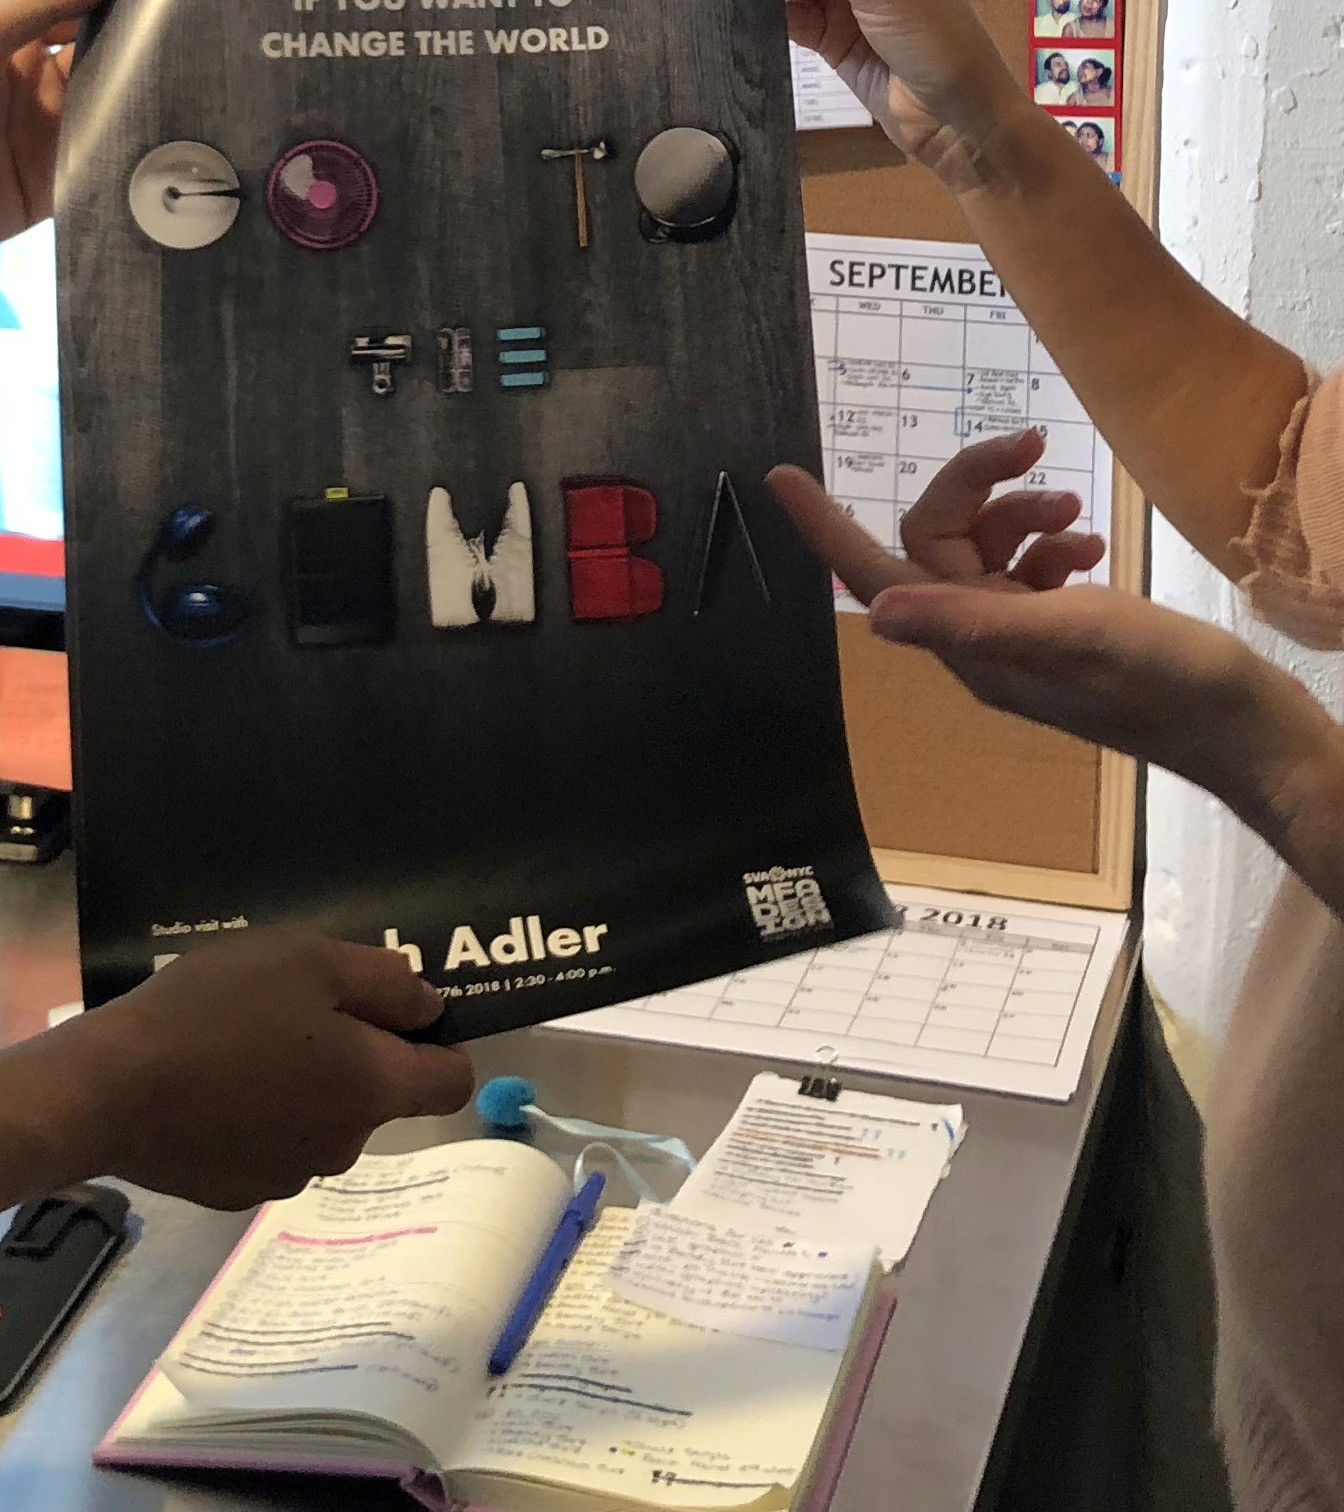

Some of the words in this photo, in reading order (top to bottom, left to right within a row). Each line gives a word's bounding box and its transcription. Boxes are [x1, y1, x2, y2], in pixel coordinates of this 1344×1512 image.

[261, 30, 406, 59] CHANGE
[414, 29, 475, 56] THE
[484, 26, 610, 55] WORLD
[828, 258, 1006, 298] SEPTEMBE
[858, 300, 881, 312] WED
[922, 304, 944, 316] THU
[989, 310, 1007, 320] FRI
[902, 368, 911, 381] 6
[967, 372, 975, 385] 7
[1031, 378, 1040, 391] 8
[838, 409, 855, 423] 12
[902, 414, 918, 428] 13
[967, 419, 983, 433] 14
[837, 455, 853, 469] 19
[899, 461, 917, 474] 20
[1029, 471, 1046, 485] 22
[746, 879, 821, 905] MFA
[152, 920, 192, 937] Studio
[195, 919, 219, 932] visit
[222, 914, 249, 929] with
[919, 907, 1009, 931] 2018
[443, 915, 608, 971] Adler
[465, 980, 501, 996] 2018
[515, 974, 546, 989] 2:30
[556, 968, 586, 982] 4:00
[588, 966, 617, 979] p.m.
